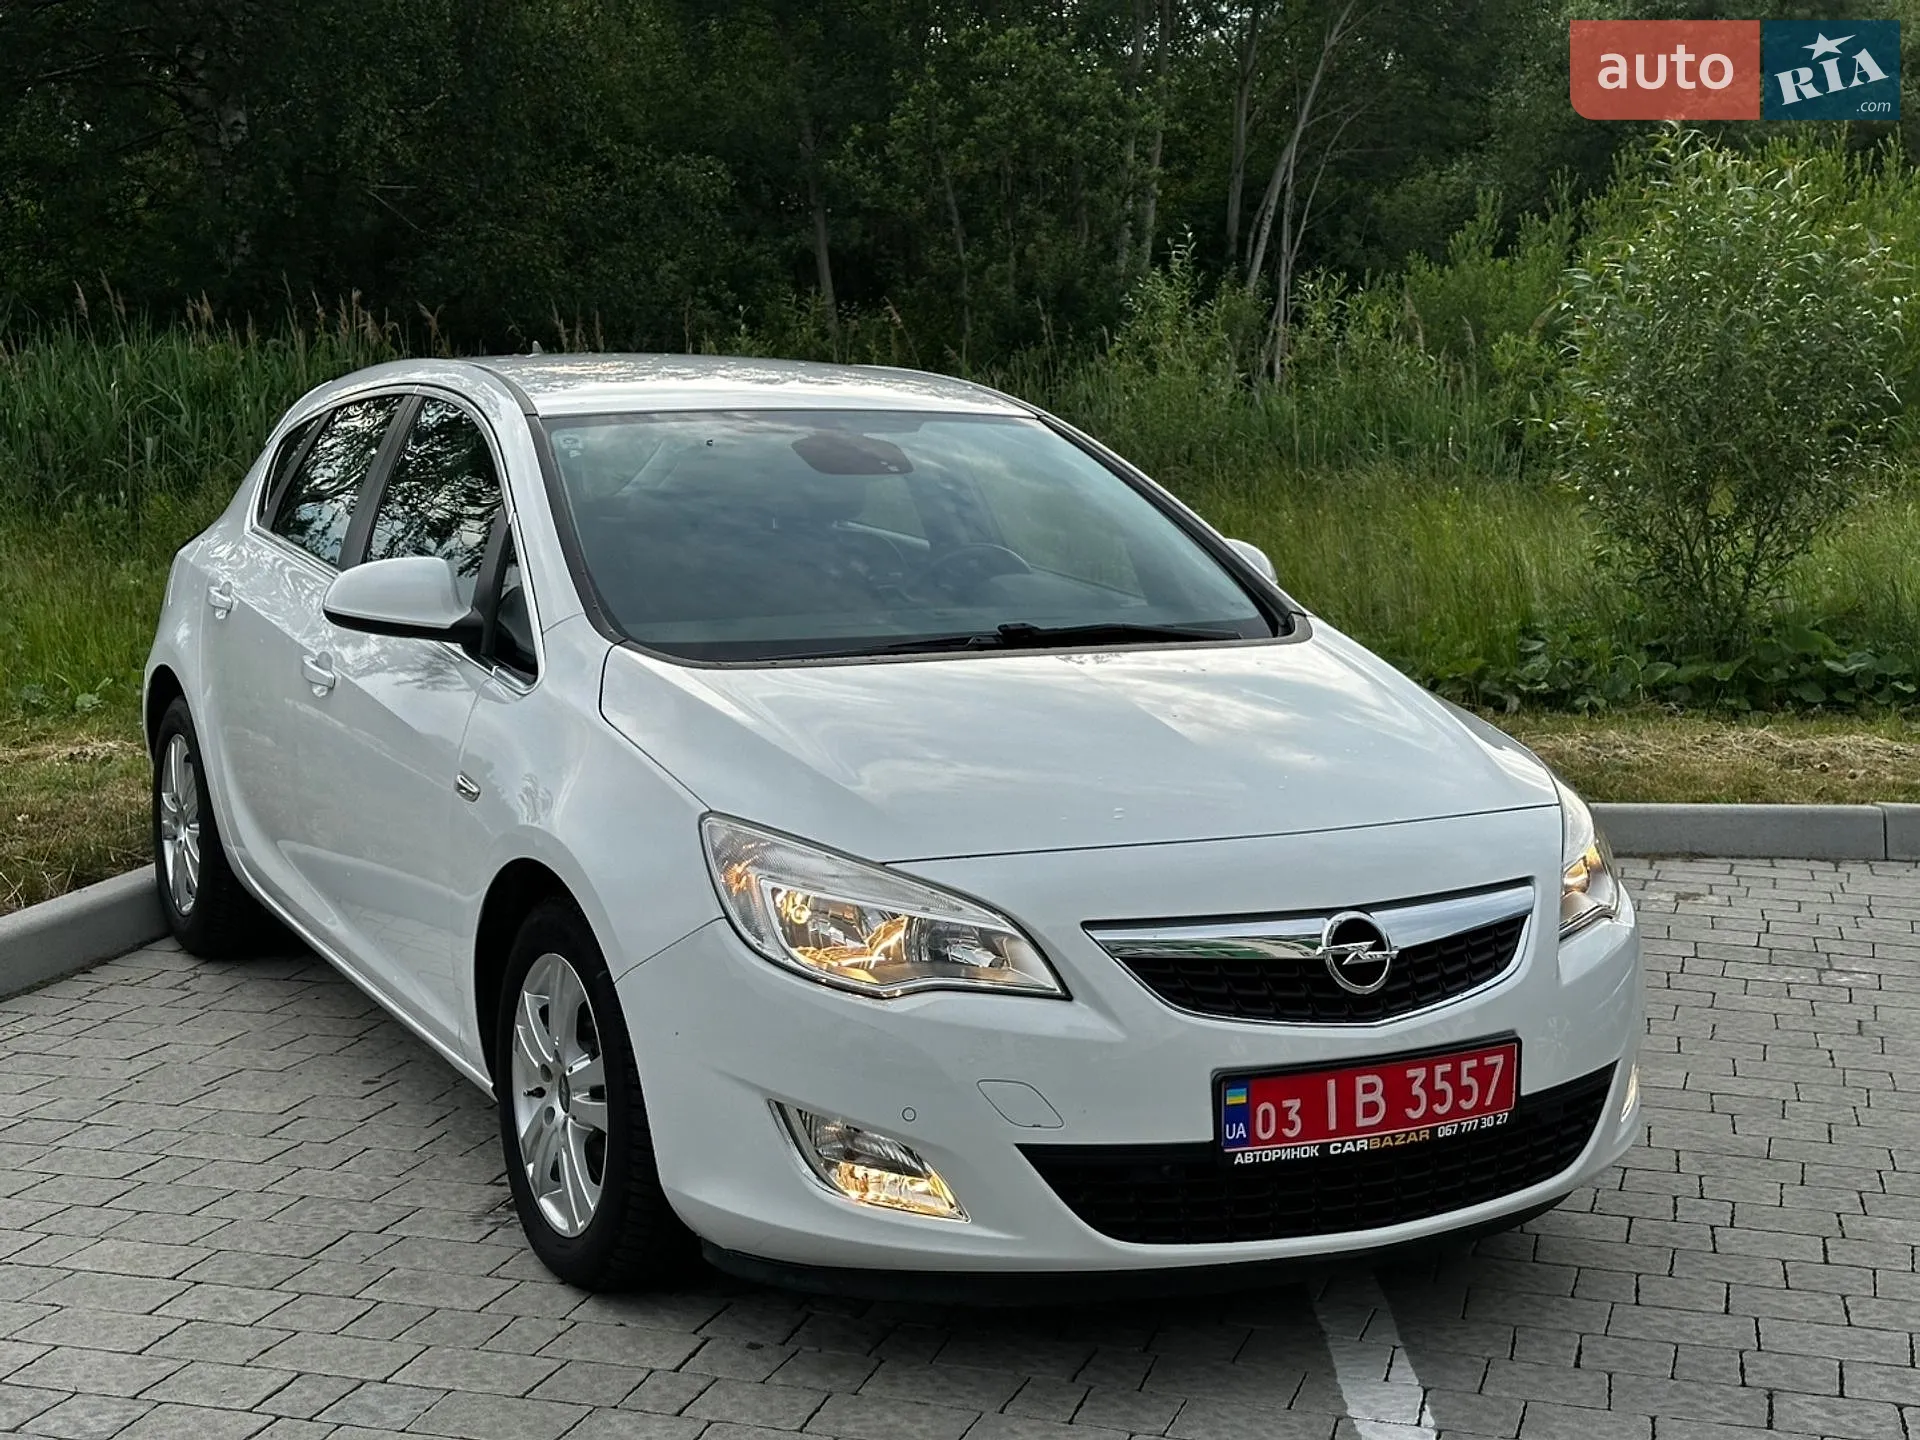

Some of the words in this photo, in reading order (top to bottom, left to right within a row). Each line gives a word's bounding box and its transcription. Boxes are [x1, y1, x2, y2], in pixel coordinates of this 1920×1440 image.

[1255, 1098, 1302, 1140] 03
[1405, 1054, 1504, 1120] 3557
[1225, 1122, 1247, 1140] UA
[1234, 1145, 1319, 1165] АВТОРИНОК
[1329, 1129, 1430, 1155] CARBAZAR
[1437, 1122, 1458, 1138] 067
[1461, 1118, 1479, 1134] 777
[1480, 1114, 1494, 1129] 30
[1496, 1111, 1509, 1125] 27
